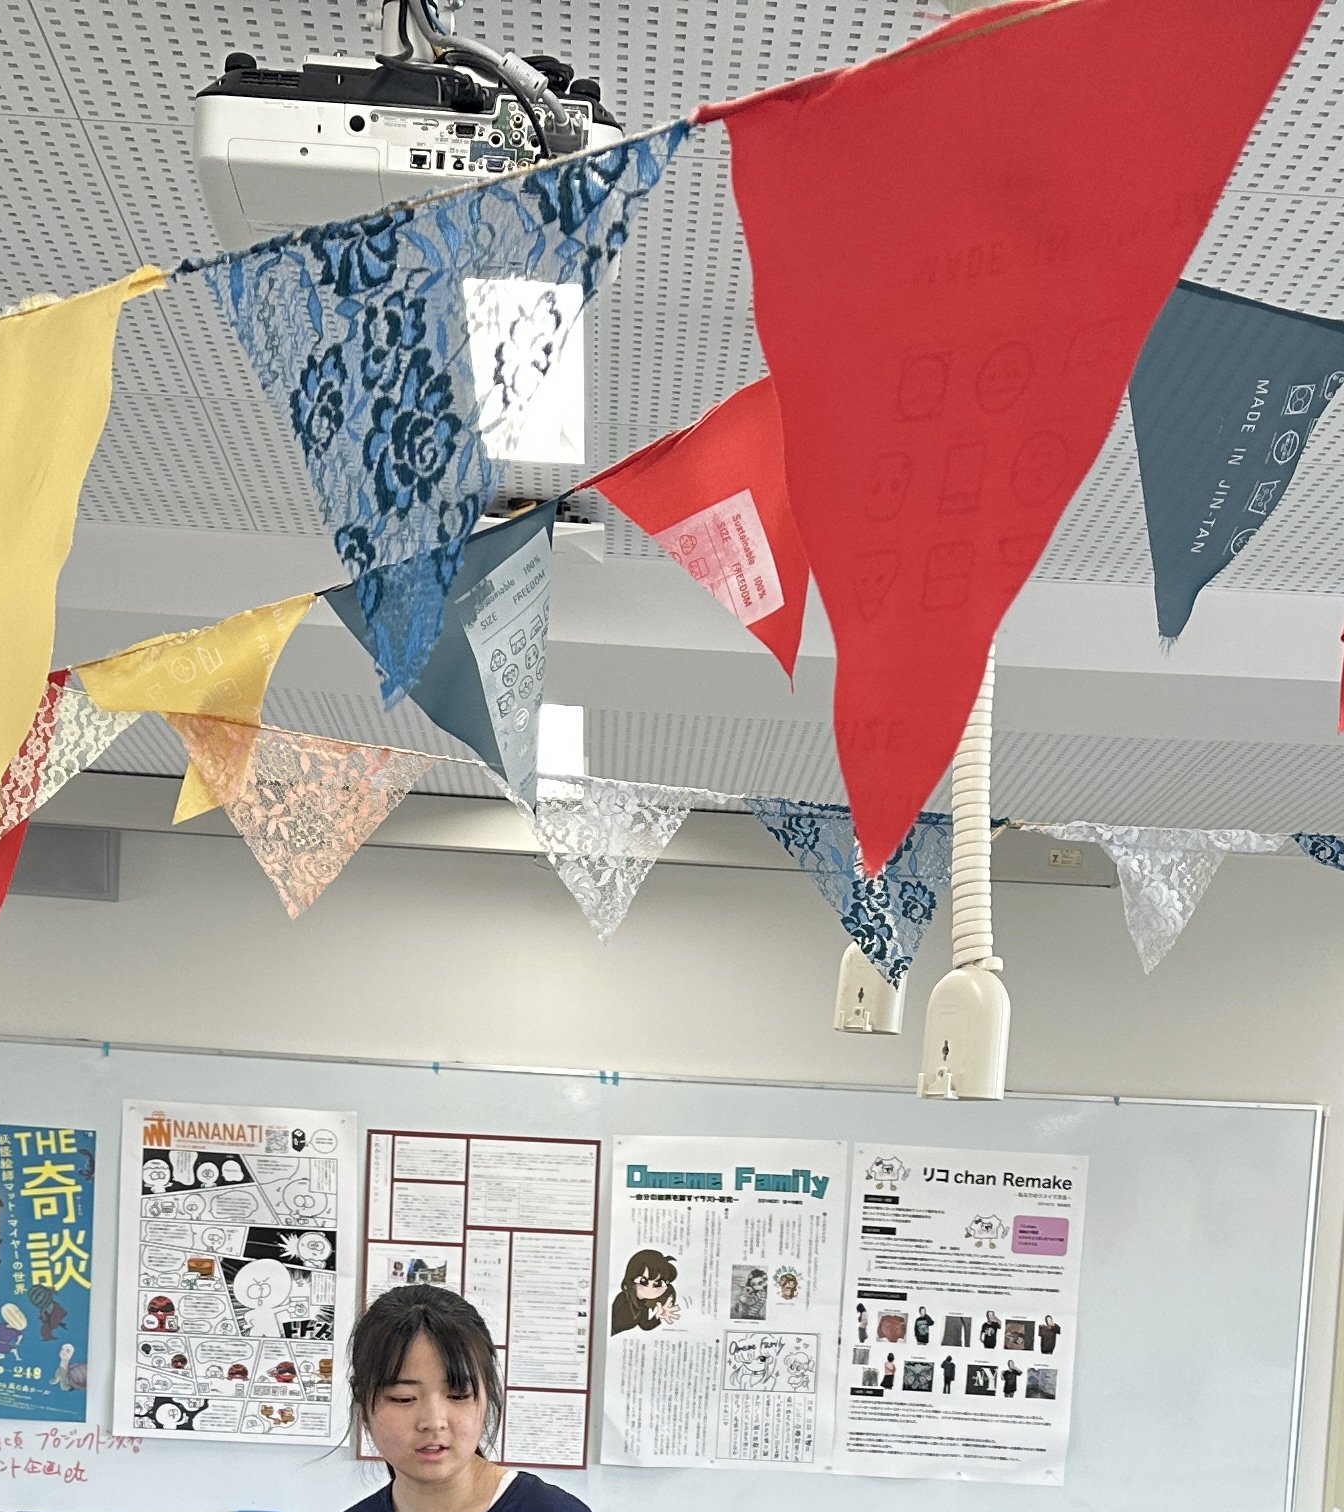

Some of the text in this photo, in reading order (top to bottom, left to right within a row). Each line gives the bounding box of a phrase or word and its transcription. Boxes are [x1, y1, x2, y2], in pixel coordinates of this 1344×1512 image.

[1190, 380, 1270, 554] MADE IN JIN-TAN
[523, 554, 542, 575] 100%
[717, 521, 753, 608] SIZE FREEDOM
[732, 514, 768, 600] Sustainable 100%
[480, 570, 546, 631] SIZE FREEDOM
[13, 1128, 78, 1157] THE
[173, 1119, 264, 1144] NANANATI
[626, 1164, 830, 1200] Omeme Family
[922, 1166, 1074, 1191] リコ chan Remake
[19, 1159, 92, 1292] 奇談
